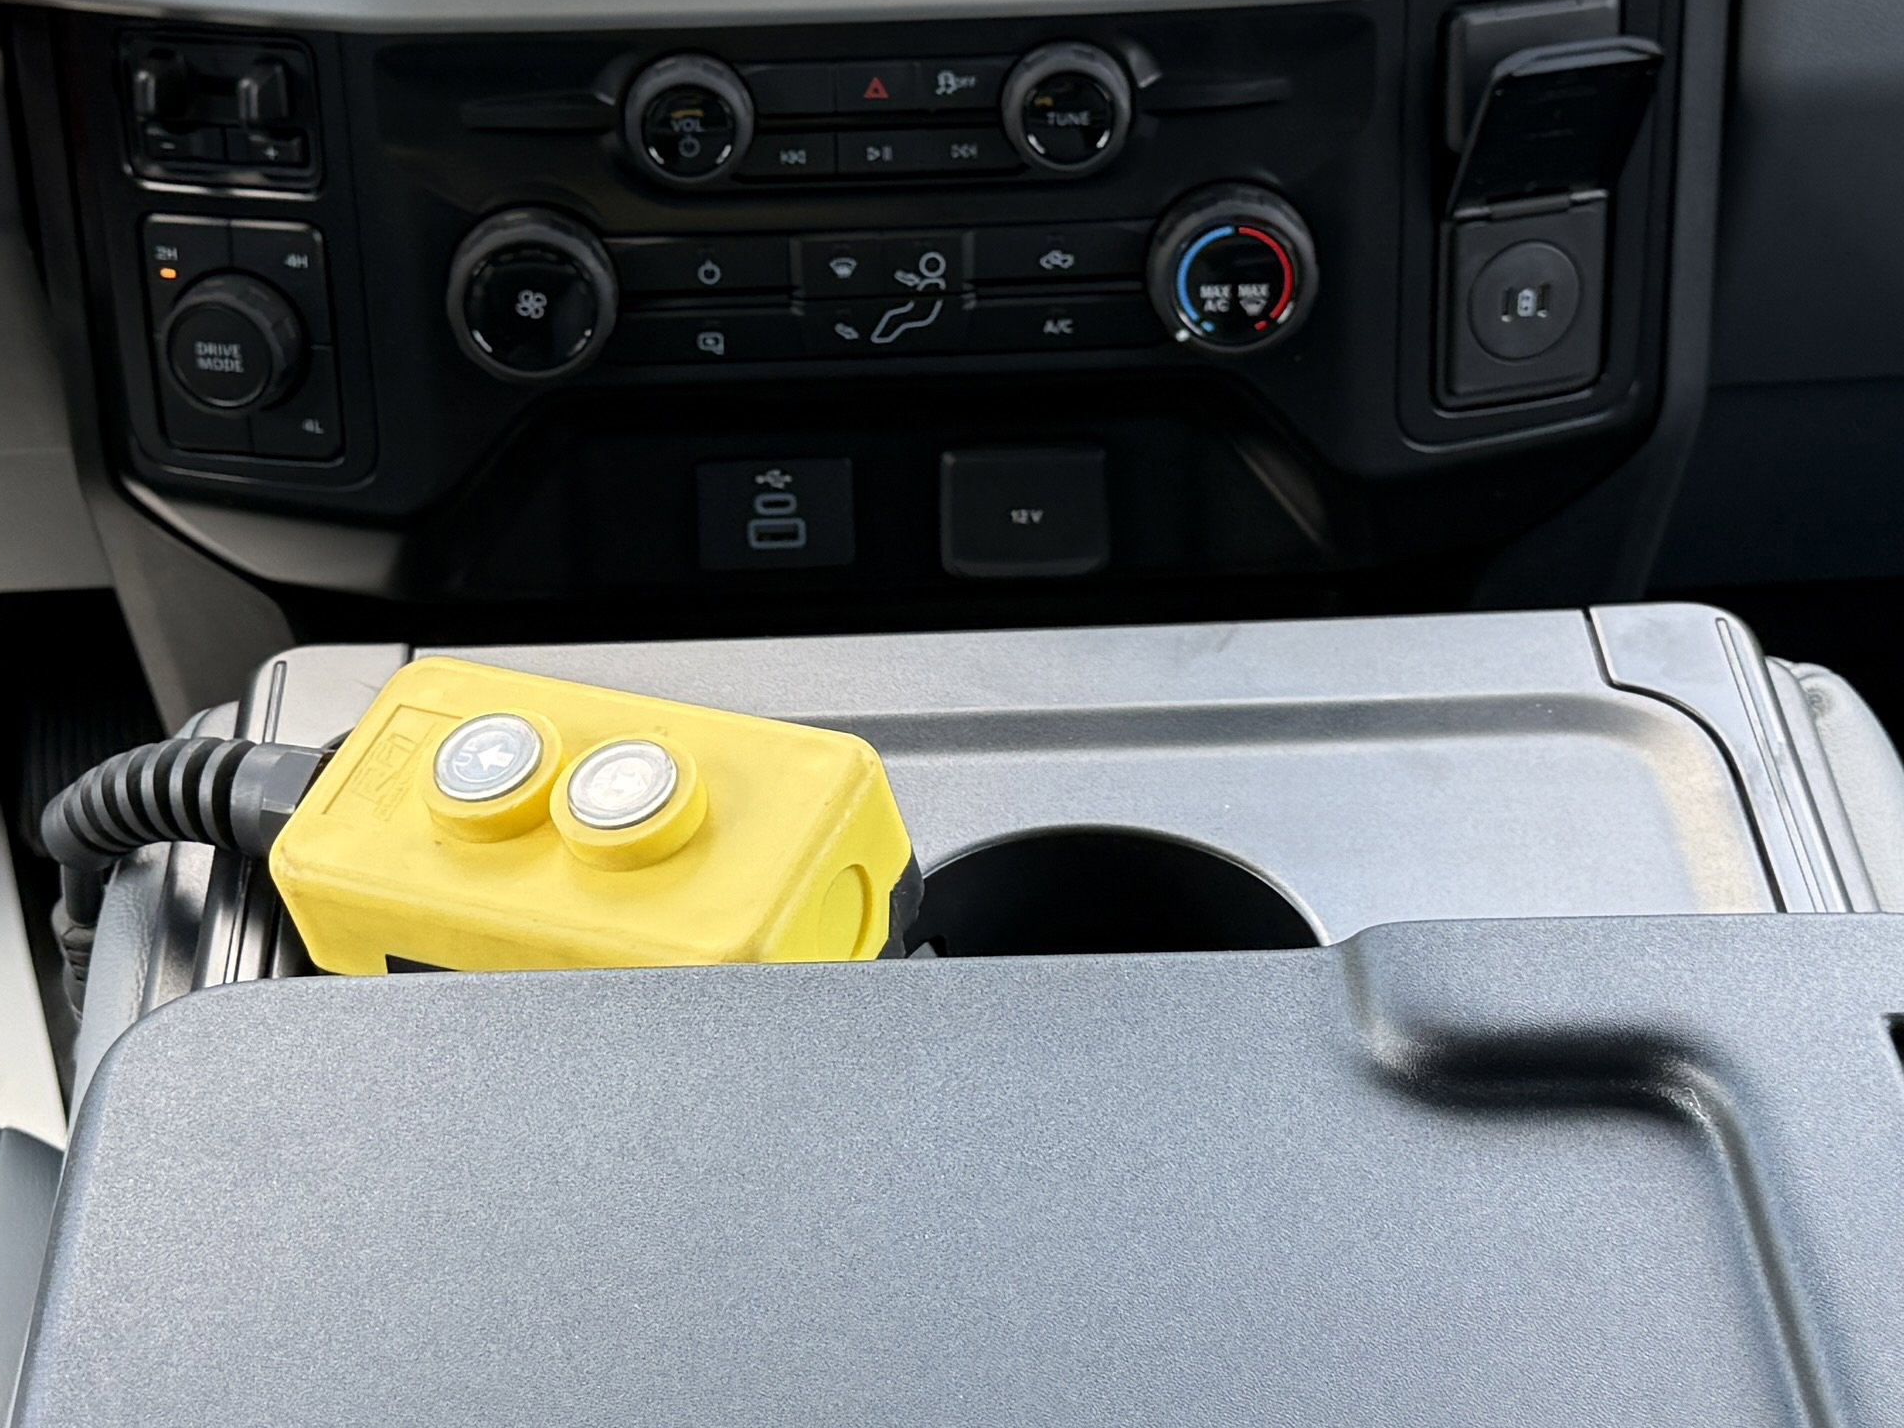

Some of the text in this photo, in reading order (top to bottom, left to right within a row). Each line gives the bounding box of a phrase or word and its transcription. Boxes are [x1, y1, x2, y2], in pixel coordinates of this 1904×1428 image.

[1046, 111, 1091, 126] TUNE
[1200, 284, 1232, 299] MAX
[1237, 283, 1271, 299] MAX
[1203, 298, 1231, 313] A/C
[1042, 318, 1074, 335] A/C
[195, 341, 242, 358] DRIVE
[196, 357, 244, 373] MODE
